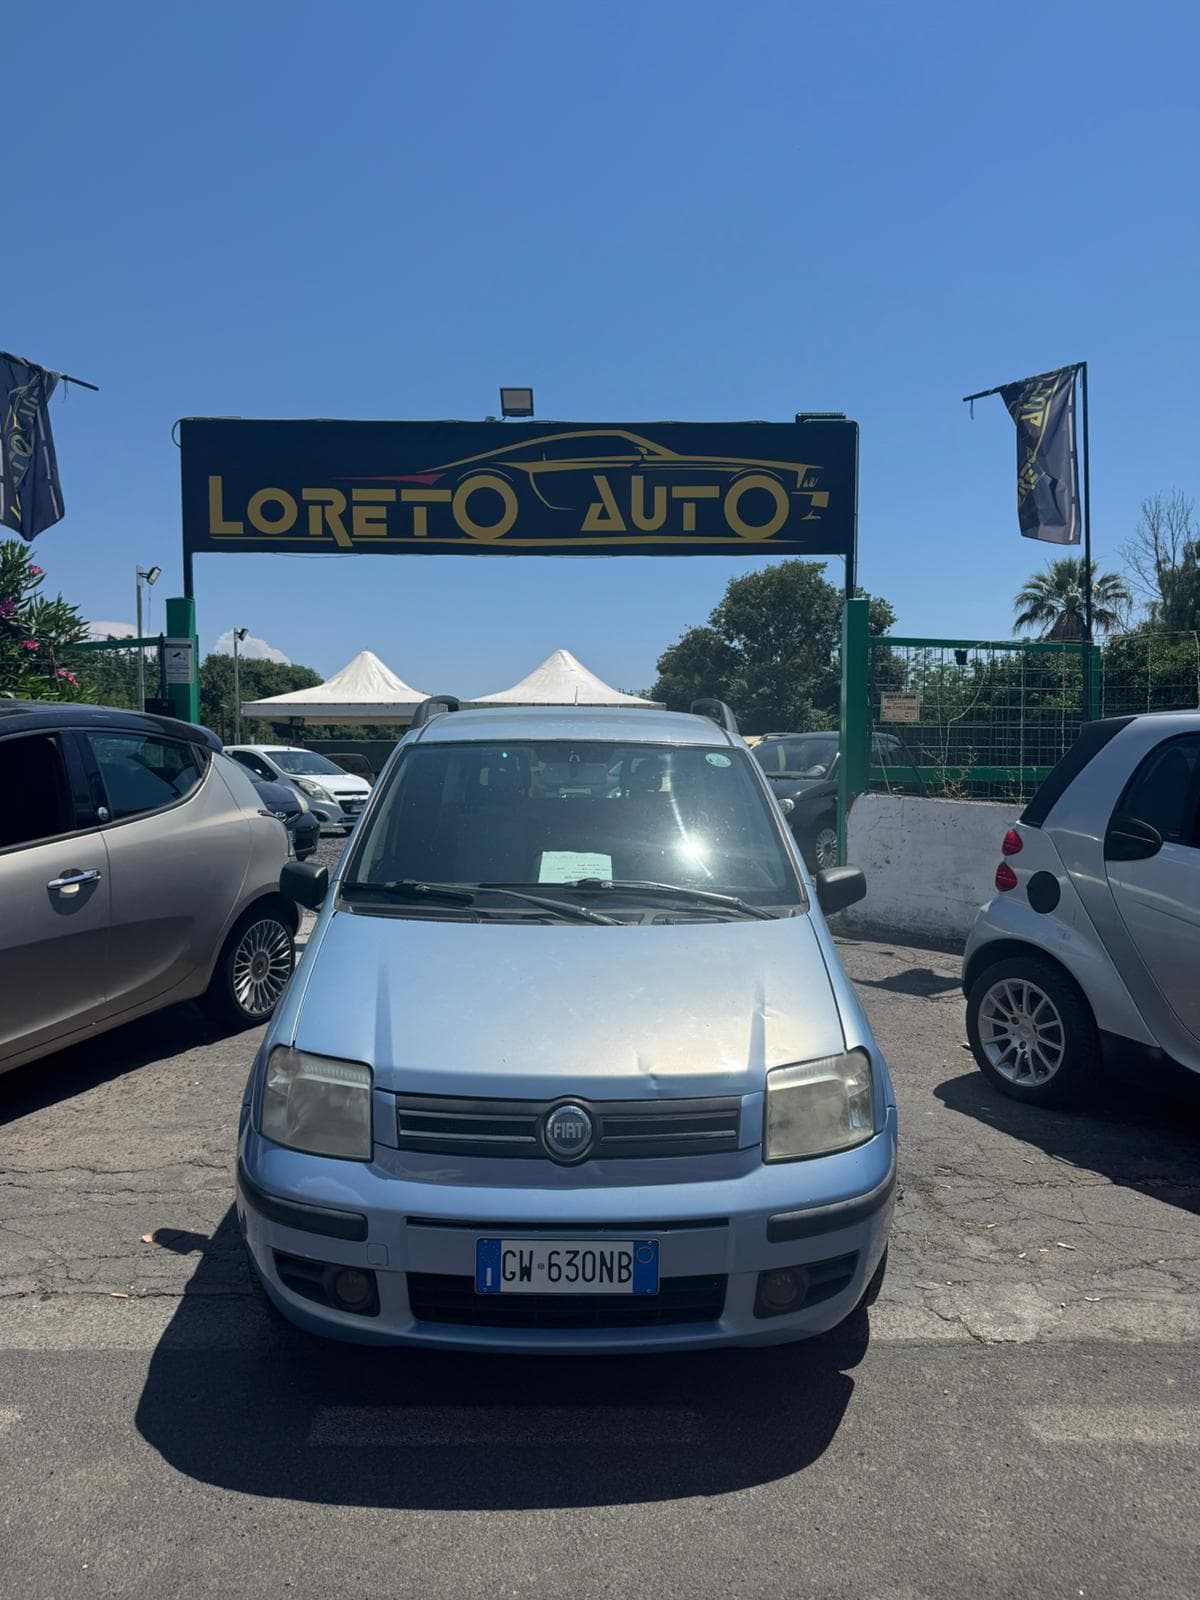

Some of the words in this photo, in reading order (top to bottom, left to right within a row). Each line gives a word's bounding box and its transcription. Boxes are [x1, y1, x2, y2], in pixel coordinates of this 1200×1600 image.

[208, 474, 519, 547] LORETO
[580, 474, 790, 539] AUTO
[553, 1121, 585, 1139] FIAT
[502, 1249, 534, 1283] GW
[547, 1250, 633, 1284] 630NB
